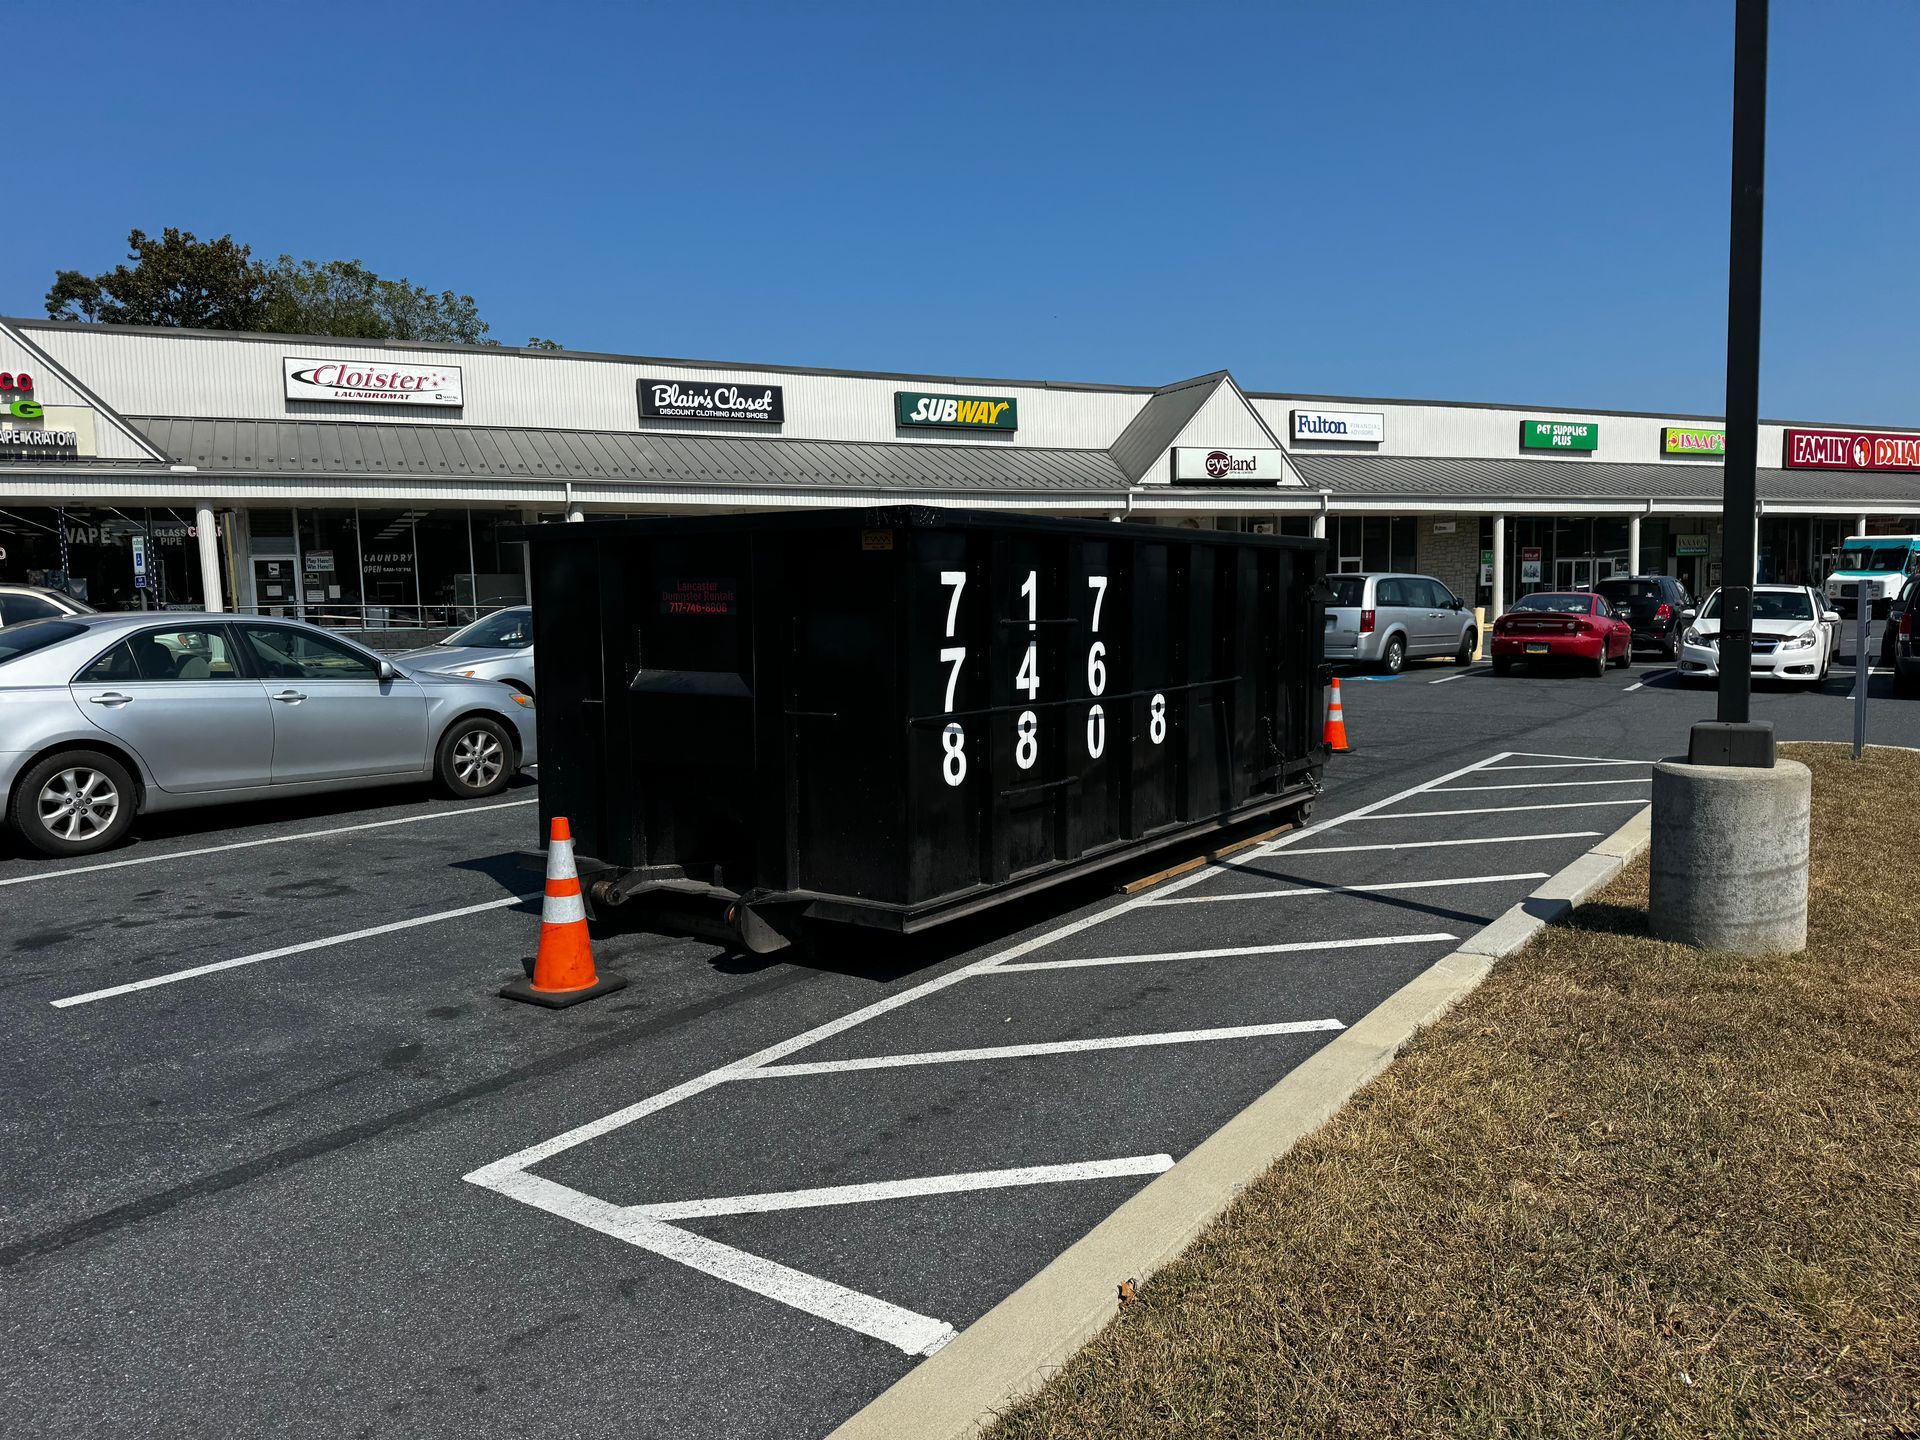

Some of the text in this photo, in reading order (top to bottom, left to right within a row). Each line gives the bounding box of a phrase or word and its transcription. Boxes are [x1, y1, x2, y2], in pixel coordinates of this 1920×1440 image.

[312, 364, 430, 391] Cloister
[334, 391, 411, 400] LAUNDROMAT
[651, 383, 773, 411] Blair's Closet
[659, 408, 695, 416] DISCOUNT
[696, 409, 730, 418] CLOTHING
[910, 398, 1010, 424] SUBWAY
[1297, 415, 1348, 434] Fulton
[1537, 424, 1588, 437] PET SUPPLIES
[25, 431, 77, 446] KRATOM
[1552, 435, 1572, 446] PLUS
[1794, 434, 1851, 464] FAMILY
[1207, 455, 1257, 475] eyeland
[64, 527, 112, 544] VAPE
[154, 528, 187, 538] GLASS
[160, 537, 183, 546] PIPE
[363, 553, 413, 562] LAUNDRY
[363, 565, 382, 573] OPEN
